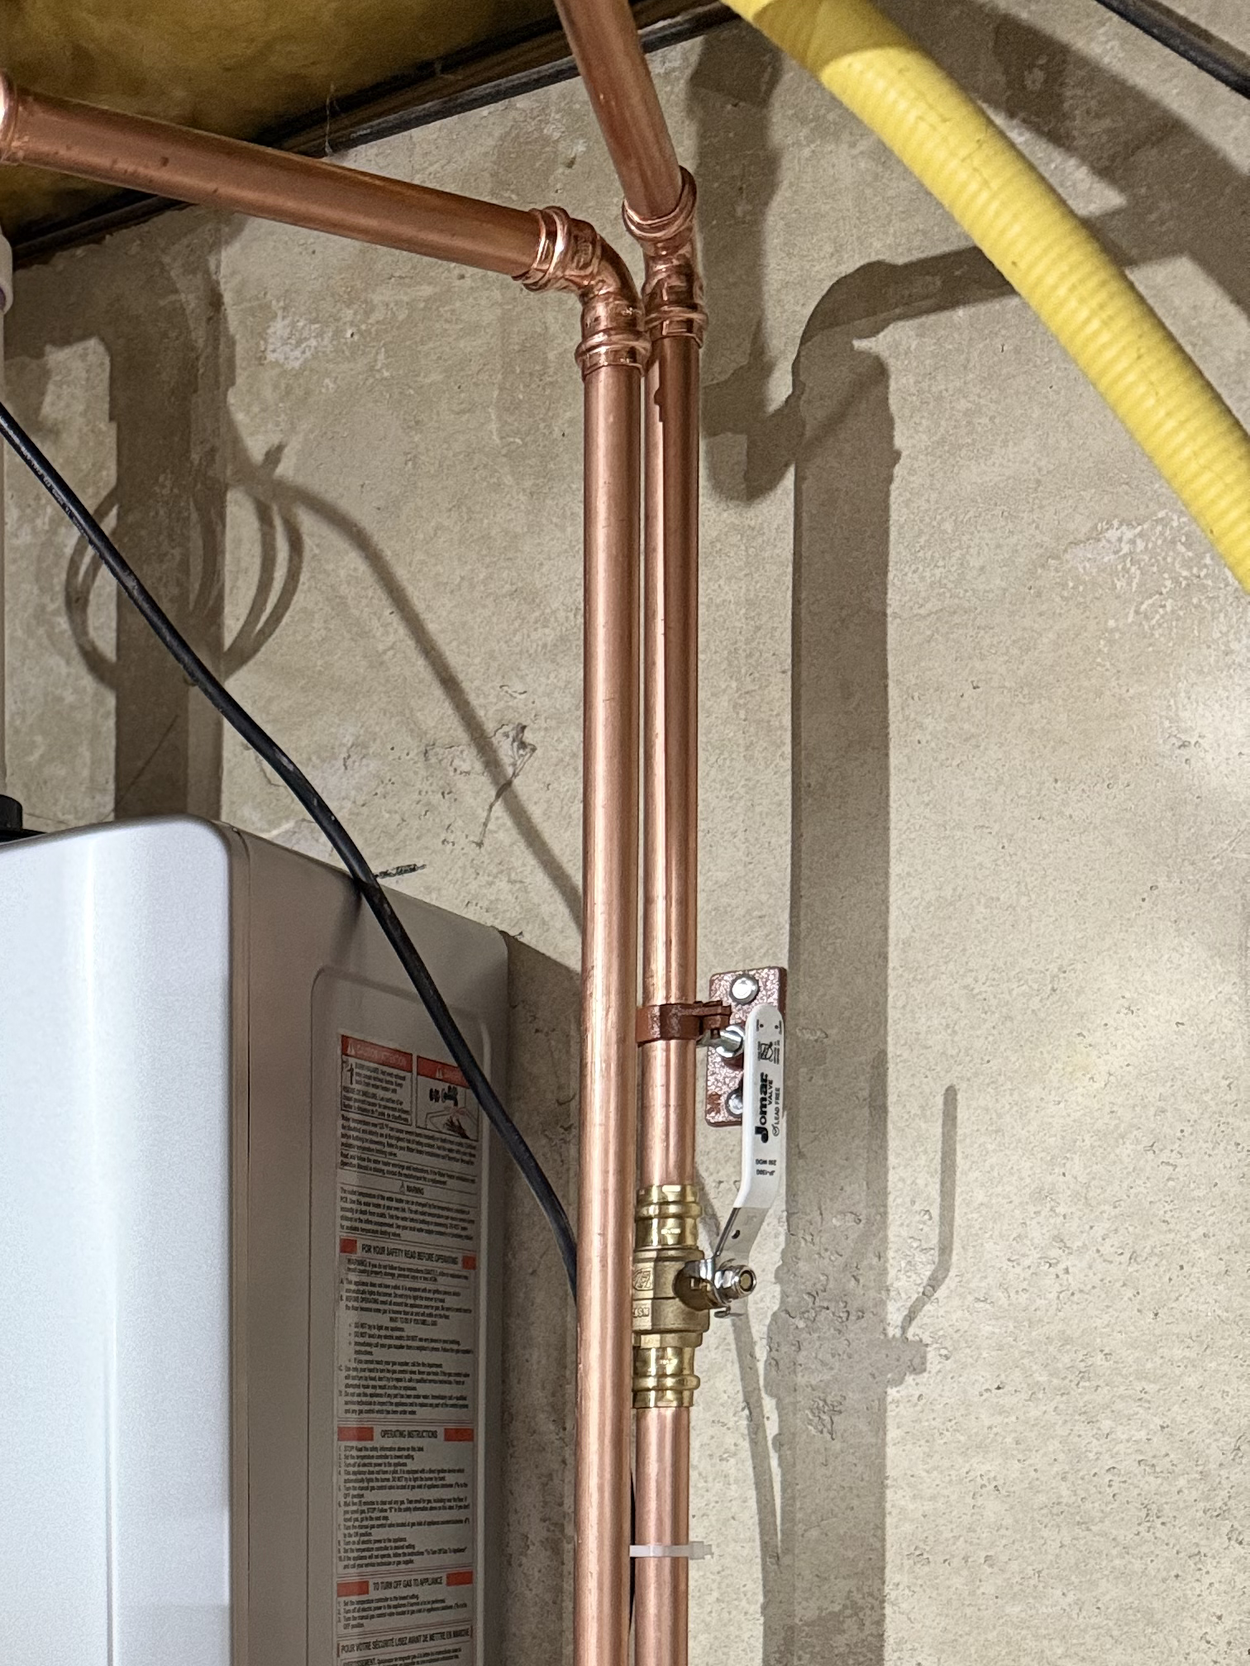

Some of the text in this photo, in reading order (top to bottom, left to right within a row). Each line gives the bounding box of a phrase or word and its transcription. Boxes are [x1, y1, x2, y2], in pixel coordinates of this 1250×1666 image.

[755, 1072, 769, 1143] Jomar
[773, 1087, 781, 1125] LEAD FREE
[361, 1244, 372, 1253] FOR
[372, 1245, 386, 1254] YOUR
[386, 1246, 404, 1256] SAFETY
[404, 1249, 417, 1258] READ
[417, 1251, 435, 1261] BEFORE
[407, 1429, 438, 1438] INSTRUCTIONS
[380, 1581, 392, 1590] TURN
[393, 1580, 402, 1590] OFF
[403, 1579, 412, 1588] GAS
[341, 1642, 355, 1653] POUR
